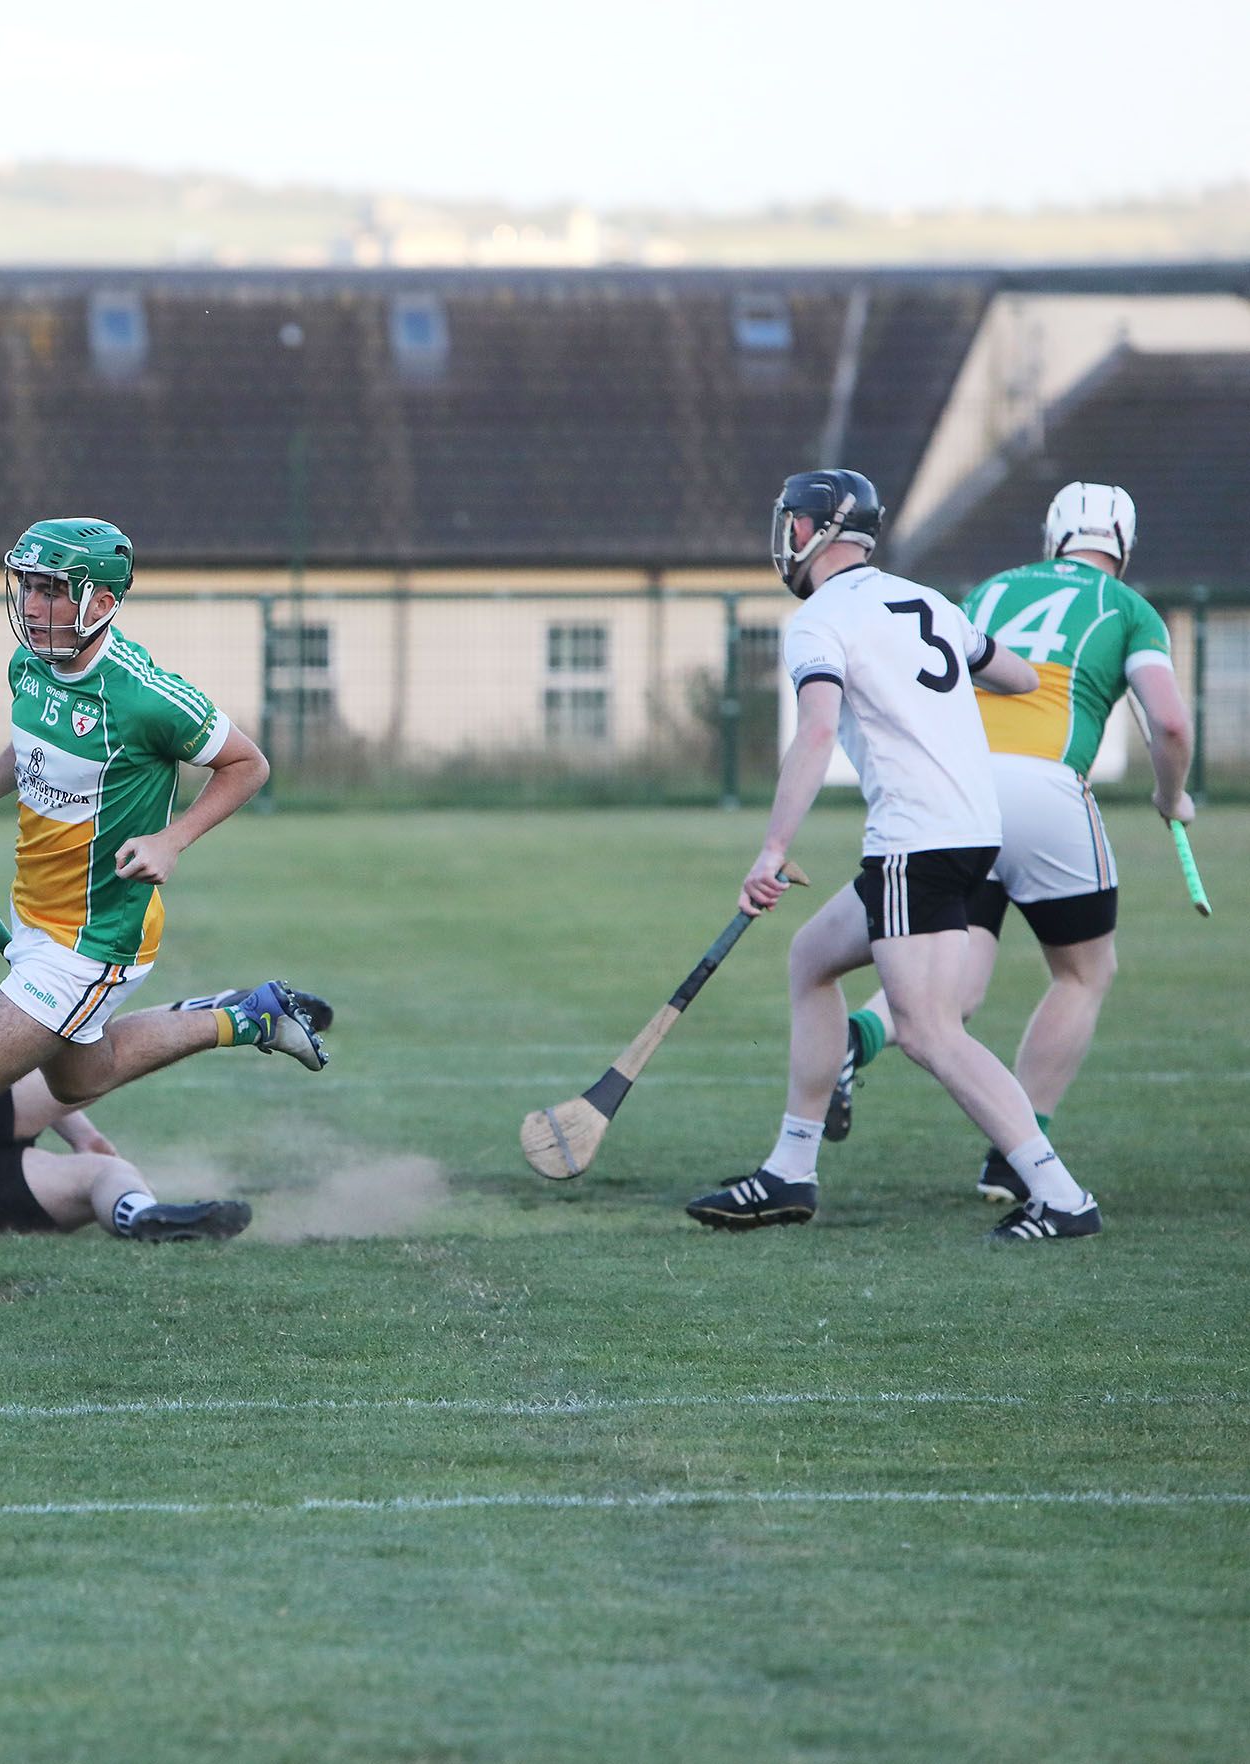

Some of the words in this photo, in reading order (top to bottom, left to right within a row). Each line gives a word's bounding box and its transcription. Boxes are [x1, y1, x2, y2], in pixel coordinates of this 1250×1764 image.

[883, 598, 959, 693] 3
[971, 582, 1080, 663] 14
[21, 675, 40, 699] GAA
[40, 696, 61, 726] 15
